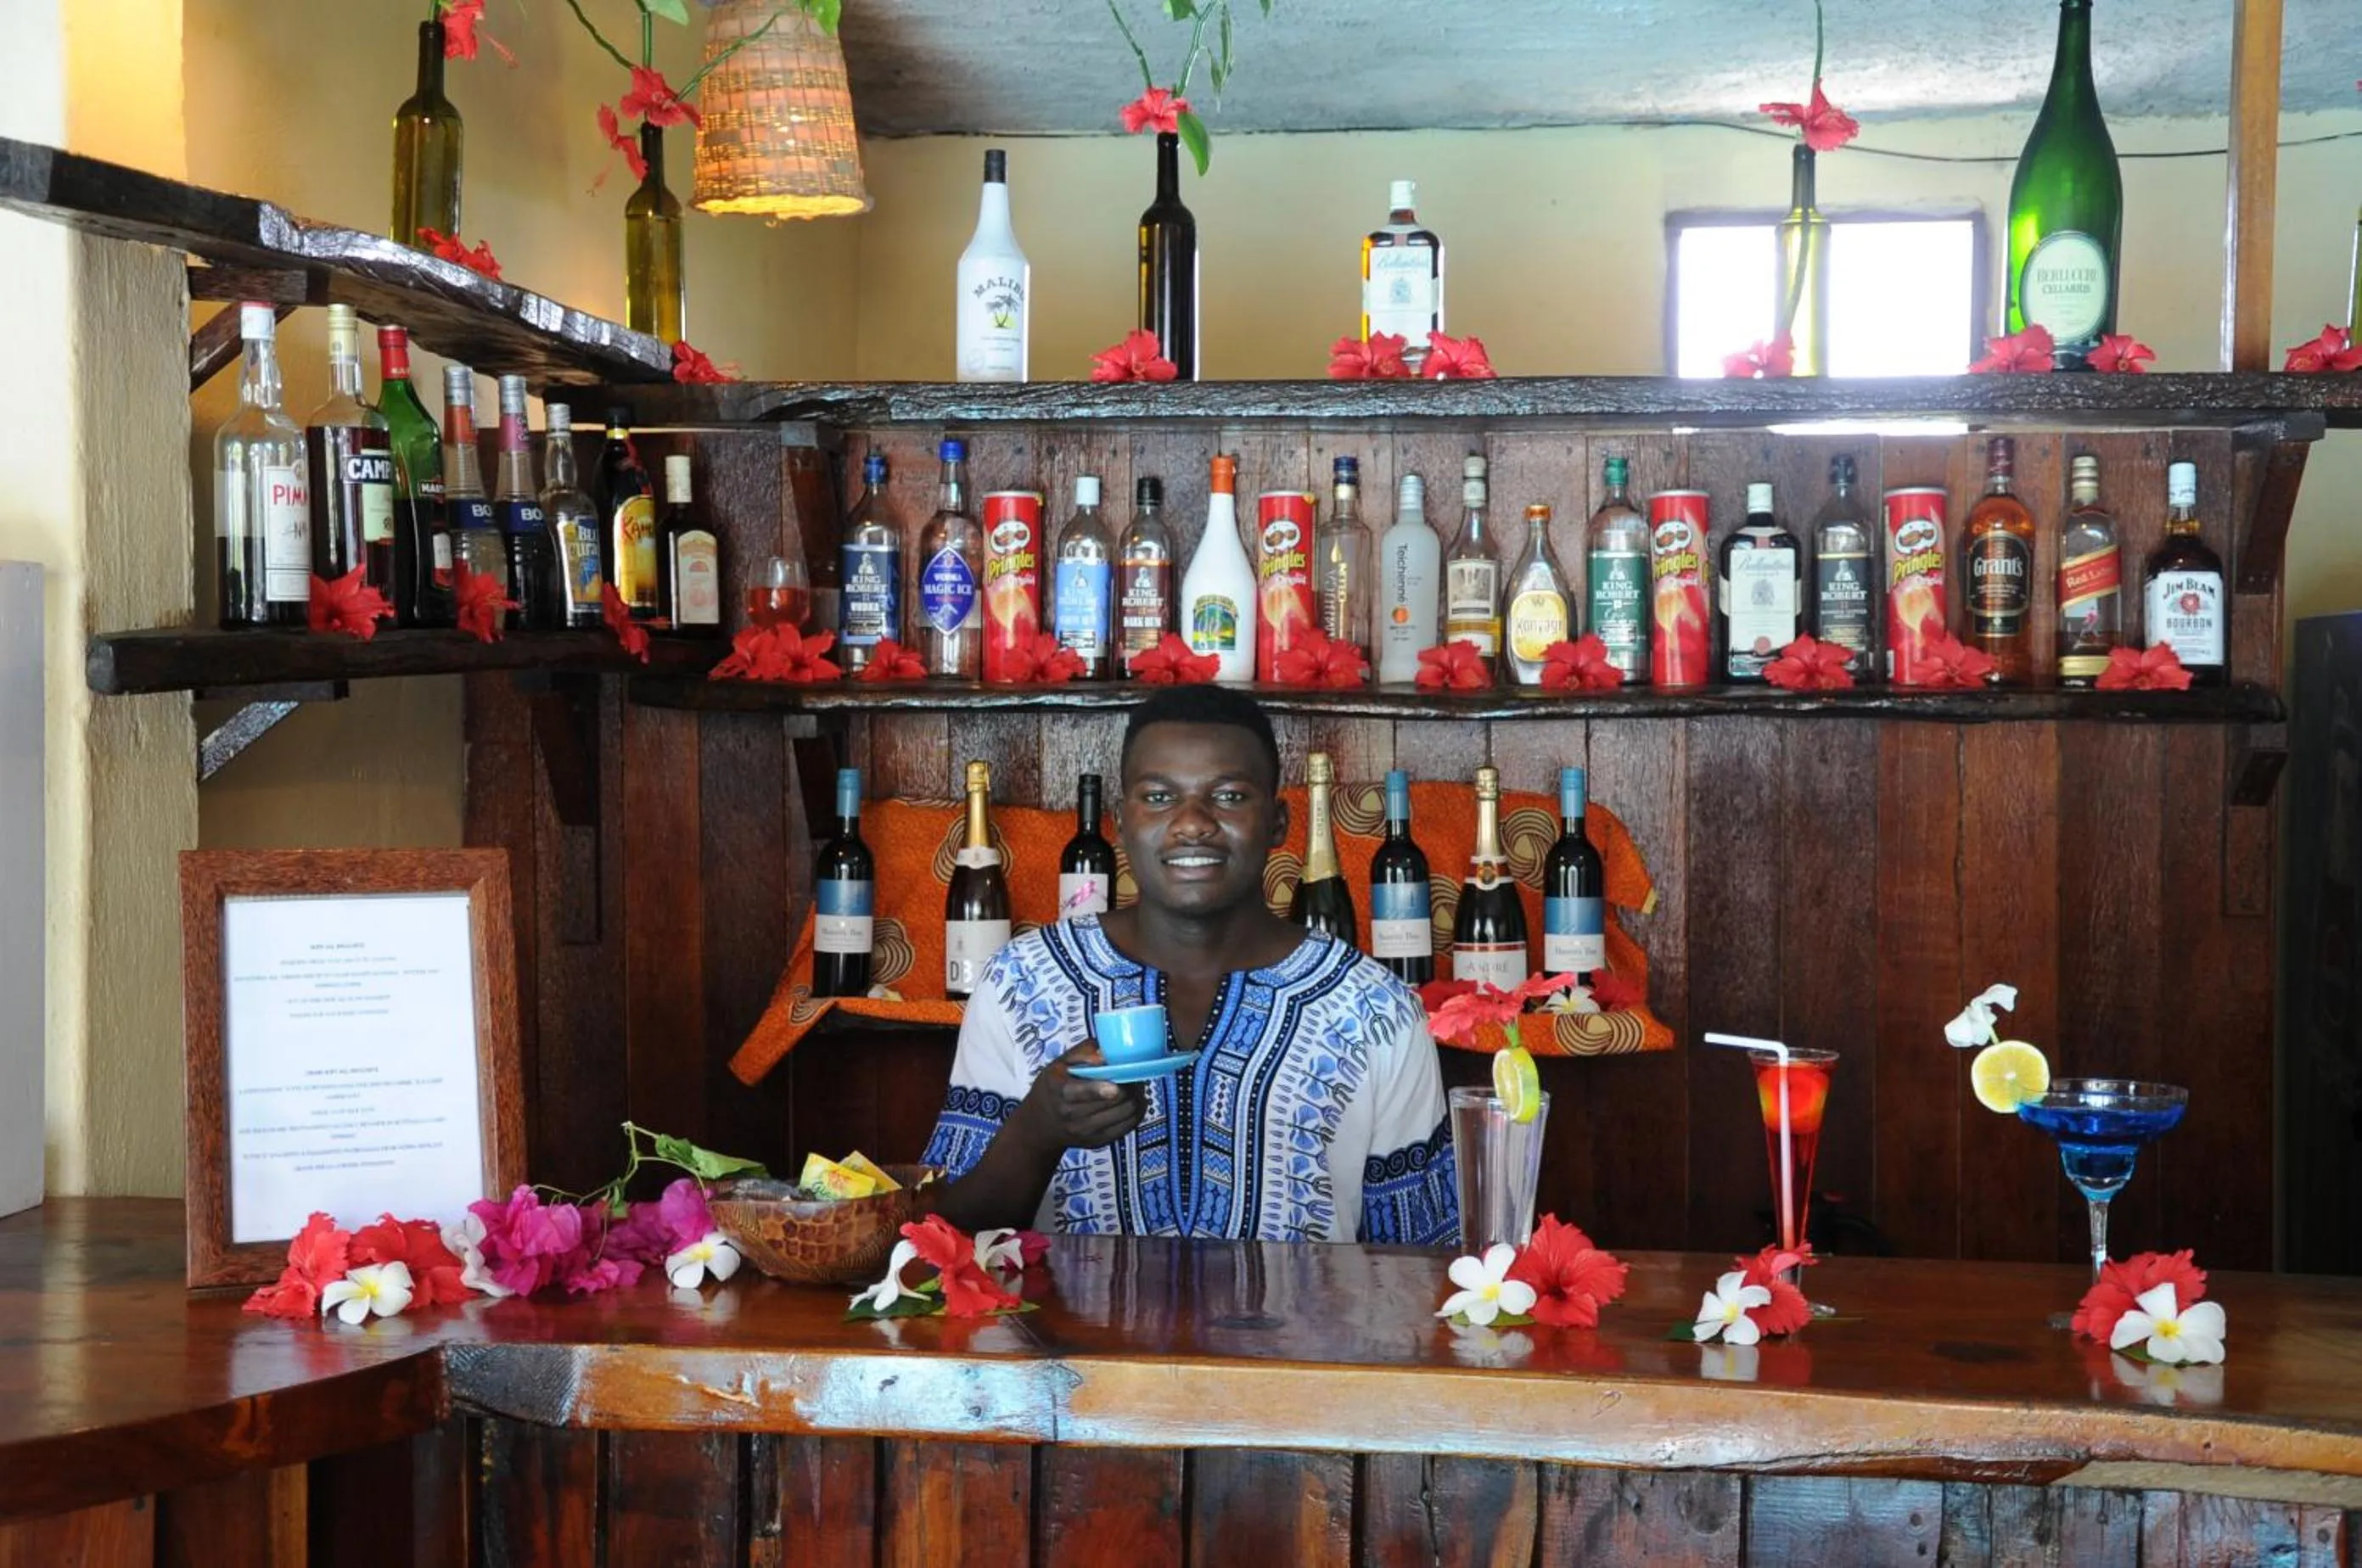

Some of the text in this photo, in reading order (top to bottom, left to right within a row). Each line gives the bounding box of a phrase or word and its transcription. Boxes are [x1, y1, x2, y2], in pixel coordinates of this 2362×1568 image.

[986, 550, 1035, 585] Pringles
[1894, 550, 1942, 585] Pringles
[1973, 557, 2023, 577] Grant's
[2066, 574, 2088, 588] Red
[2163, 577, 2215, 599] JIM BEAM
[2166, 618, 2213, 629] BOURBON
